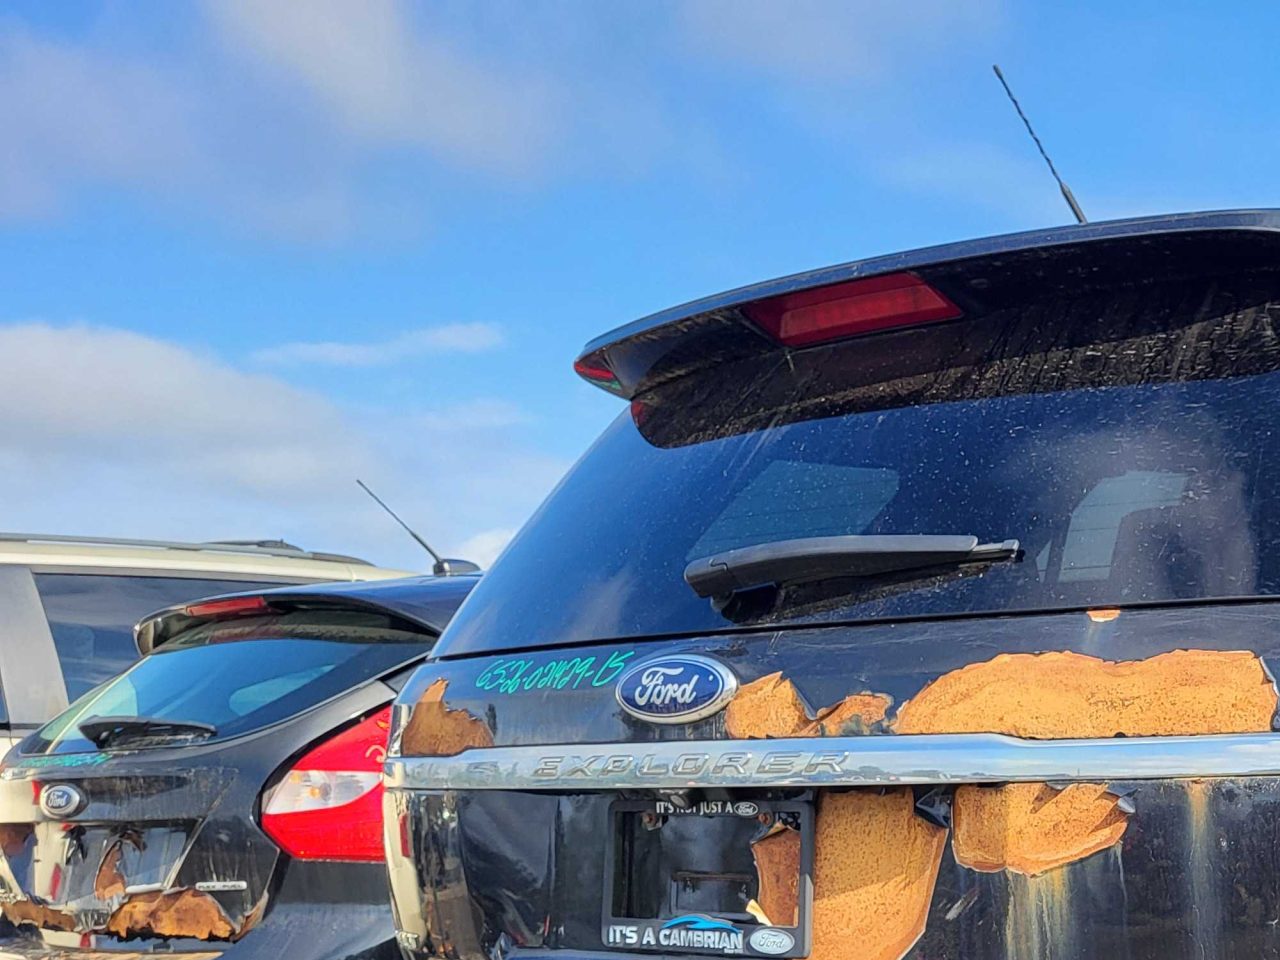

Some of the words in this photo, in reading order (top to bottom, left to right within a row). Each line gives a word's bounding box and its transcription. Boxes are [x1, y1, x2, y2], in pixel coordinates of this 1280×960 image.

[634, 666, 700, 706] Ford
[532, 750, 850, 780] EXPLORER
[48, 790, 68, 808] Ford
[656, 801, 674, 814] IT'S
[700, 801, 723, 816] JUST
[725, 801, 734, 814] A
[608, 925, 638, 945] IT'S
[642, 927, 656, 945] A
[659, 928, 744, 950] CAMBRIAN
[758, 932, 785, 949] Ford
